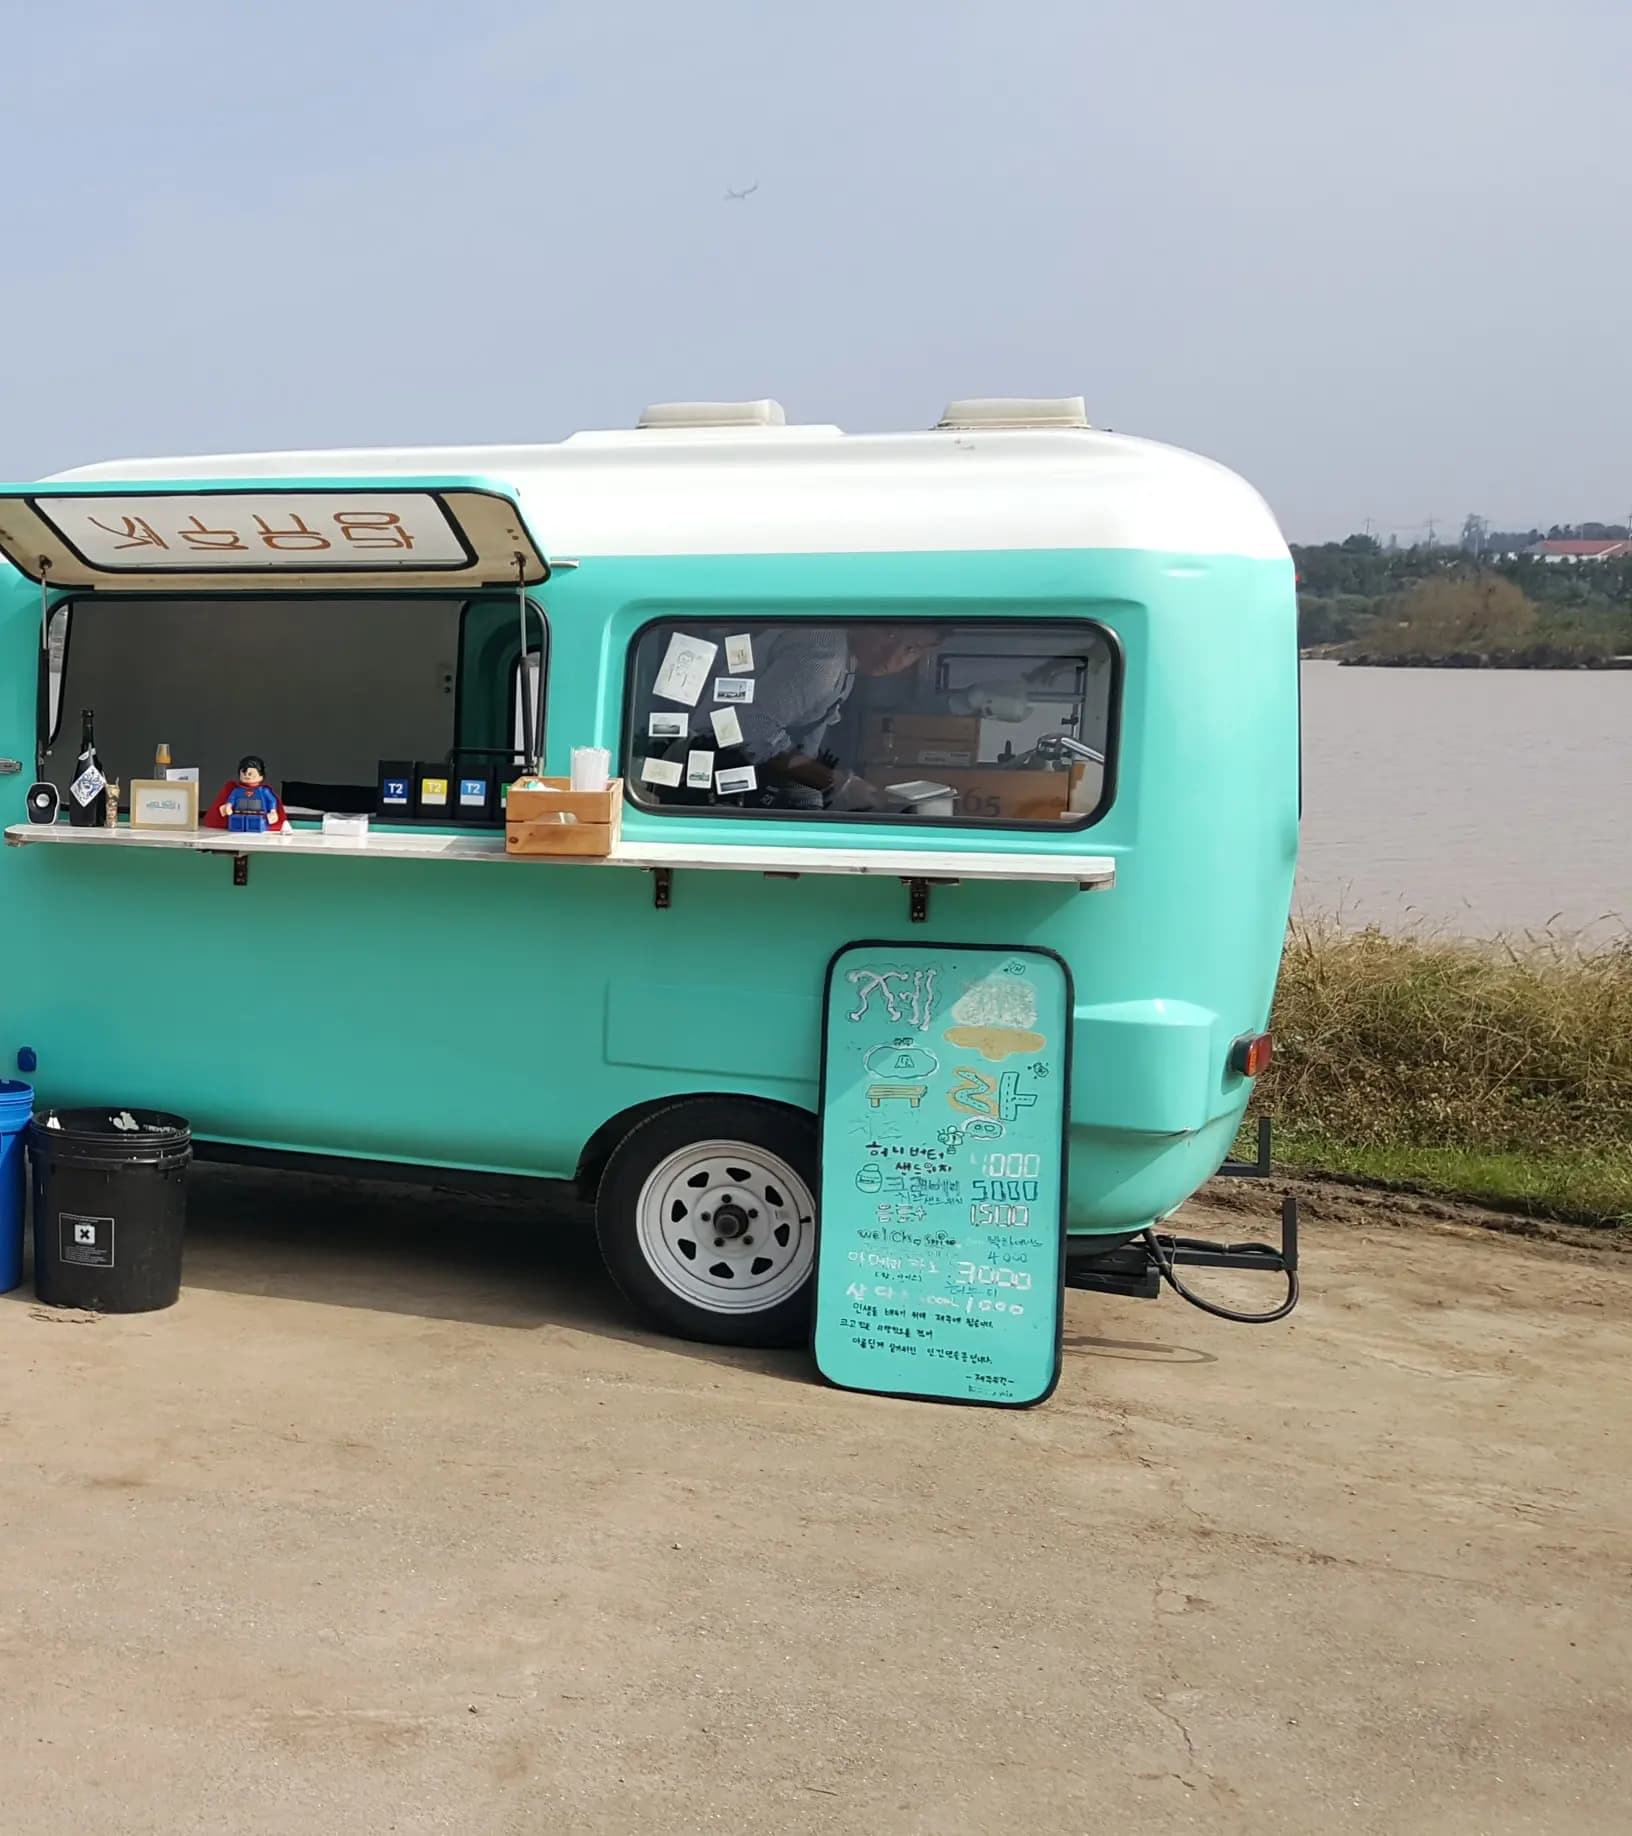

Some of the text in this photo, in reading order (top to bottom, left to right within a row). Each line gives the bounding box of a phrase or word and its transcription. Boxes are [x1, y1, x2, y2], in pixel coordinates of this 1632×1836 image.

[388, 783, 404, 794] T2
[427, 782, 441, 793] T2
[466, 783, 480, 794] T2
[971, 1180, 1038, 1202] 5000
[955, 1261, 1032, 1290] 3000
